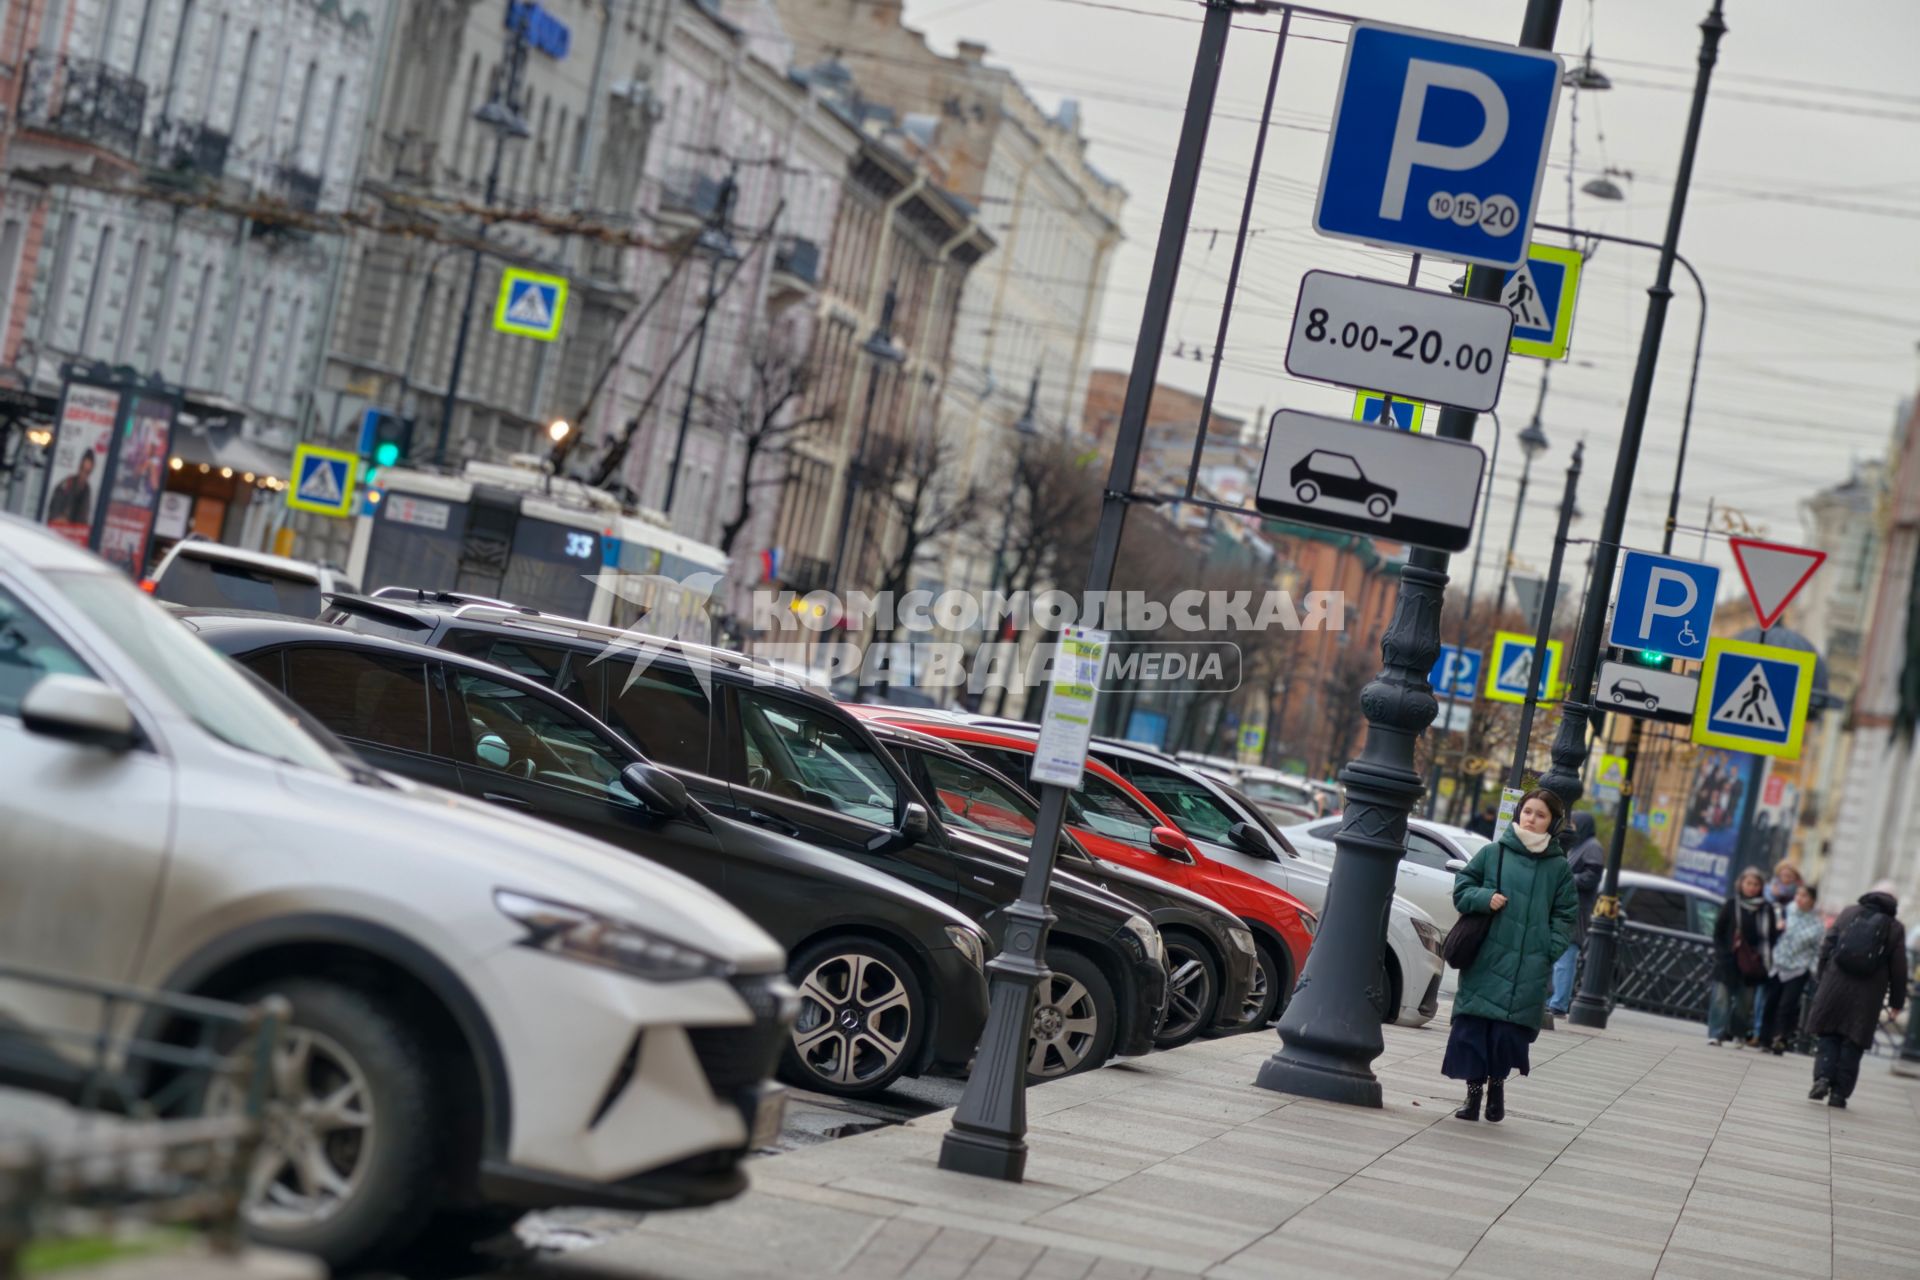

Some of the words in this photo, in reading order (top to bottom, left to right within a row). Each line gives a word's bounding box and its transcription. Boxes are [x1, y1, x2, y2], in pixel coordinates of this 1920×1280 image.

[1379, 57, 1509, 221] P
[1435, 198, 1450, 213] 10
[1457, 200, 1476, 219] 15
[1483, 203, 1515, 228] 20
[1304, 308, 1492, 374] 8.00-20.00
[565, 532, 594, 558] 33
[1638, 565, 1698, 640] P
